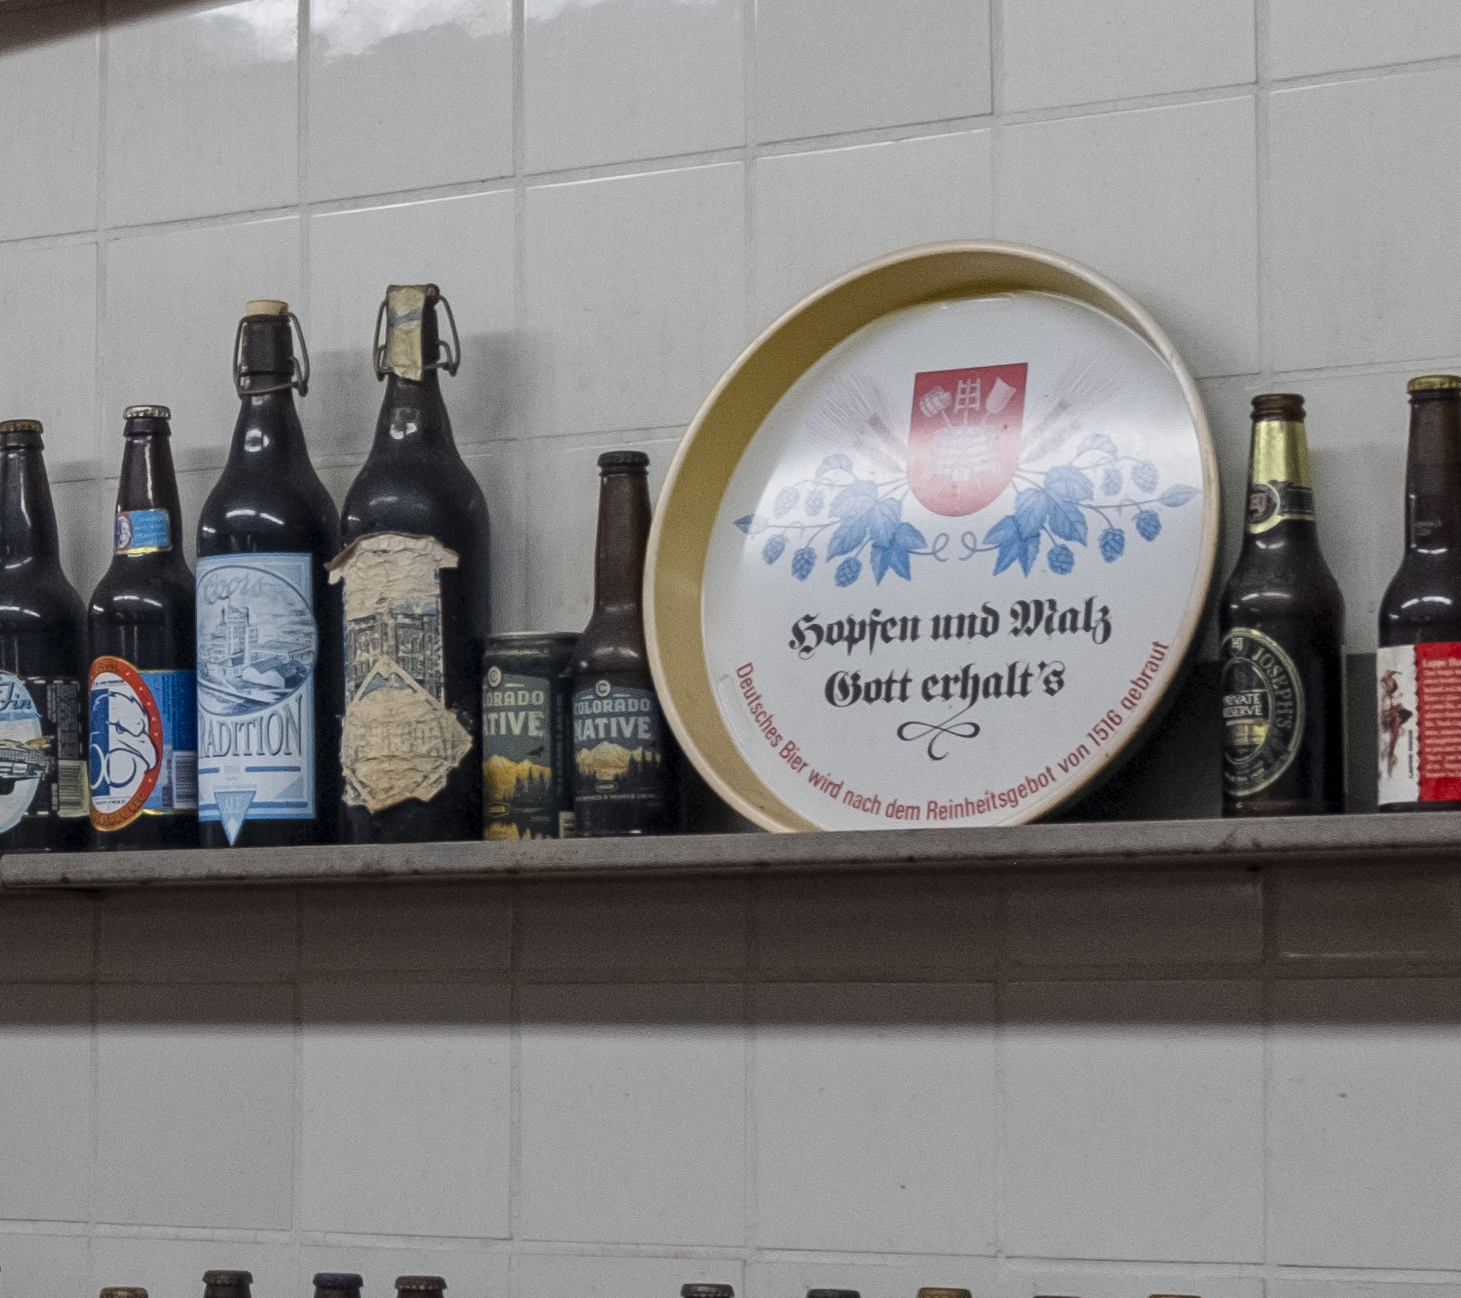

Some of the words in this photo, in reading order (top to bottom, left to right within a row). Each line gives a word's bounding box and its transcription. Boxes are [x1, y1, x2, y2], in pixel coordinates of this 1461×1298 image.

[202, 571, 270, 605] Coors
[930, 601, 1001, 643] und
[824, 668, 913, 708] Gott
[735, 661, 784, 749] Deutsches
[778, 739, 810, 775] Bier
[807, 768, 845, 800] wird
[842, 788, 882, 816] nach
[885, 798, 922, 821] dem
[925, 764, 1057, 822] Reinheitsgebot
[1056, 743, 1091, 774] von
[1085, 708, 1125, 749] 1516
[1119, 639, 1171, 714] gebraut
